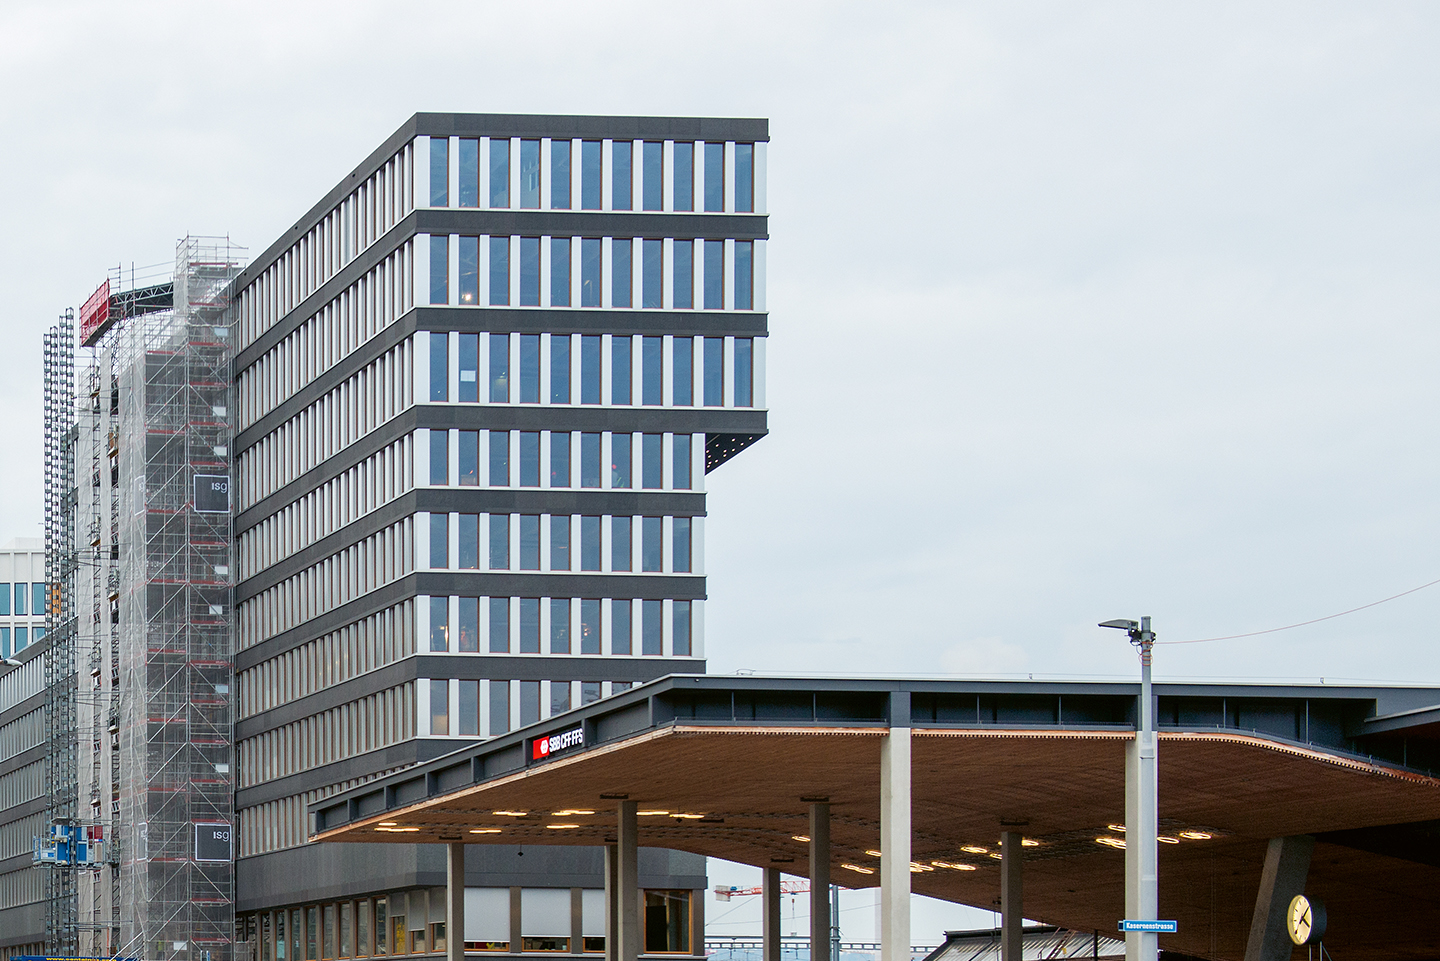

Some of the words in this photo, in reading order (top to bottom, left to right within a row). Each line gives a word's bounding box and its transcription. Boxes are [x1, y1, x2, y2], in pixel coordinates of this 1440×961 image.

[549, 736, 561, 752] SBB
[561, 731, 572, 749] CFF
[571, 728, 583, 745] FFS
[1126, 922, 1174, 930] Kasernenstrasse
